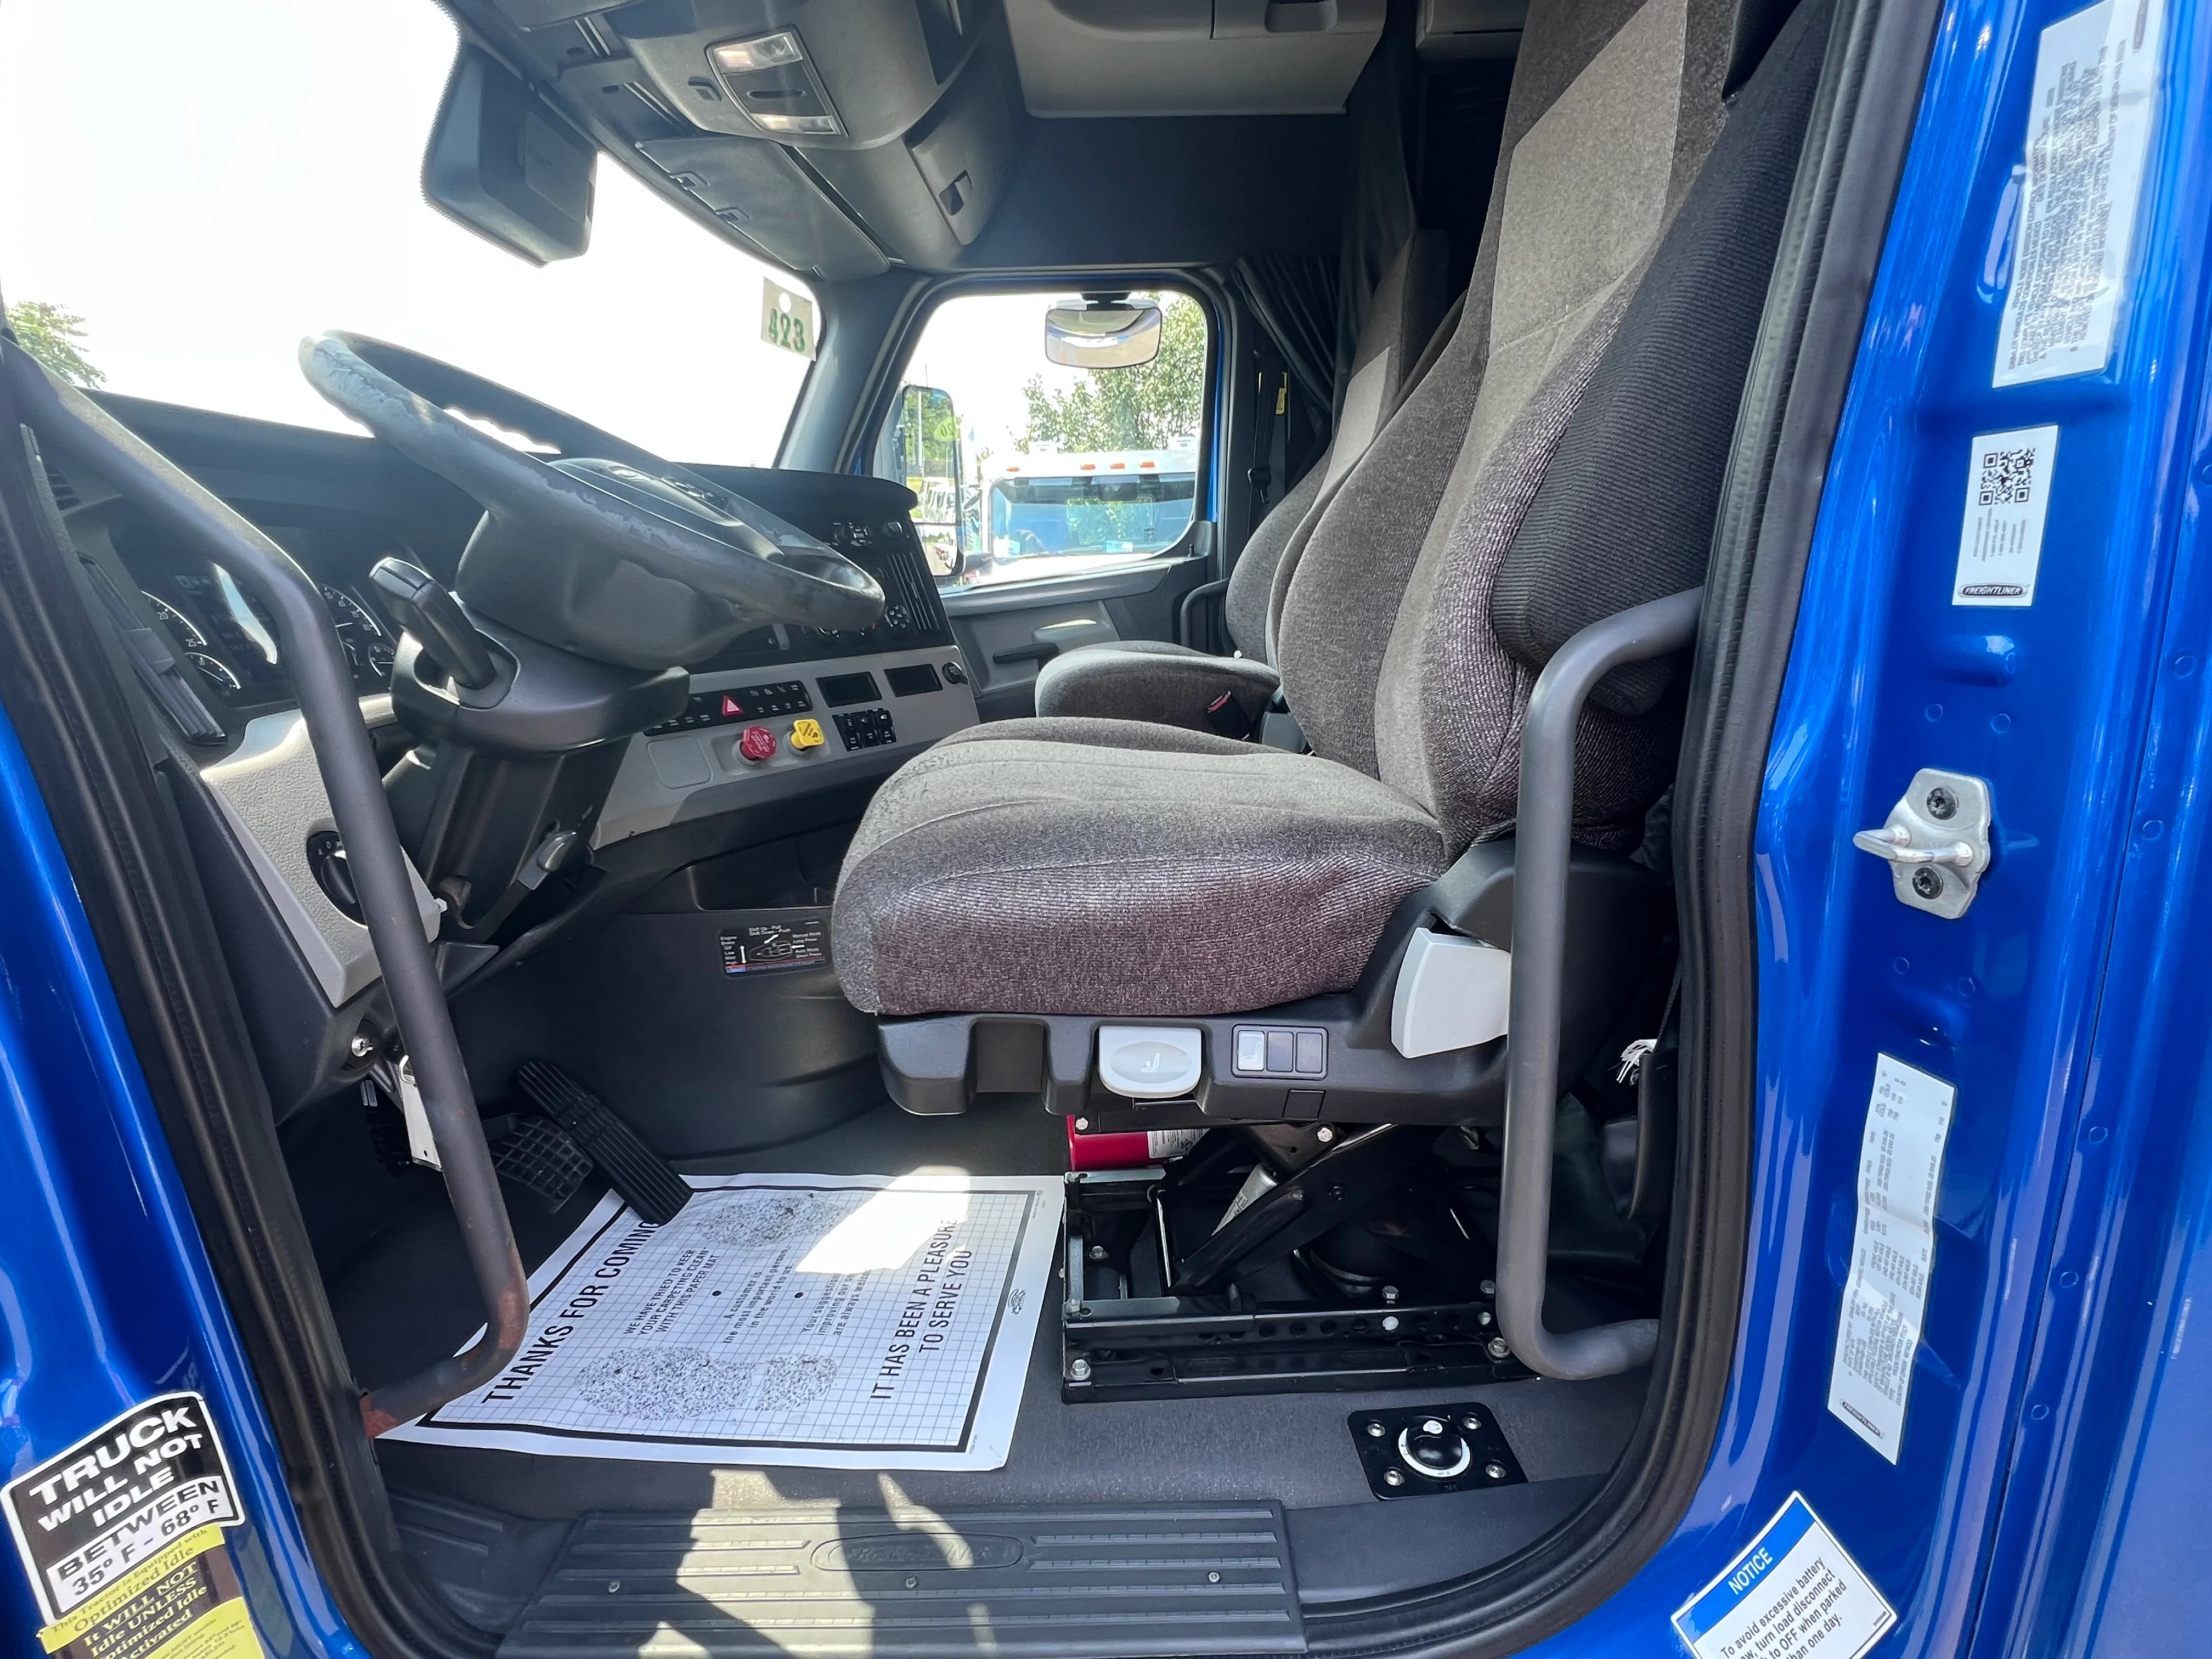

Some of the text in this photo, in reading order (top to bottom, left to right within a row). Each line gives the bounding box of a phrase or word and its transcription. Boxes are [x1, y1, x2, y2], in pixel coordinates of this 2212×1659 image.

[769, 308, 805, 353] 423
[917, 1220, 957, 1282] PLEASURE
[623, 1249, 696, 1334] WE HAVE TRIED TO KEEP
[637, 1314, 662, 1335] YOUR
[655, 1272, 694, 1312] CARPETING
[654, 1254, 721, 1332] WITH THIS PAPER MAT
[727, 1280, 758, 1312] customer
[752, 1307, 769, 1318] the
[761, 1285, 782, 1305] world
[894, 1302, 927, 1338] BEEN
[918, 1250, 972, 1352] TO SERVE YOU
[481, 1325, 574, 1404] THANKS
[558, 1285, 609, 1318] FOR
[721, 1331, 739, 1343] the
[731, 1310, 752, 1328] most
[801, 1315, 819, 1333] Your
[870, 1384, 894, 1398] IT
[879, 1344, 910, 1375] HAS
[29, 1407, 197, 1505] TRUCK
[38, 1434, 203, 1532] WILL NOT
[92, 1466, 174, 1527] IDLE
[57, 1481, 219, 1581] BETWEEN
[122, 1545, 138, 1564] F
[209, 1499, 219, 1514] F
[134, 1540, 183, 1578] Equipped
[184, 1530, 207, 1543] with
[74, 1569, 161, 1632] Optimized
[164, 1546, 194, 1572] Idle
[177, 1585, 207, 1610] Idle
[1728, 1548, 1773, 1595] NOTICE
[83, 1632, 100, 1646] It
[102, 1595, 156, 1632] WILL
[156, 1562, 196, 1594] NOT
[90, 1629, 126, 1658] Idle
[128, 1577, 197, 1629] UNLESS
[1720, 1557, 1825, 1658] To avoid excessive battery
[1755, 1631, 1776, 1651] turn
[1773, 1611, 1795, 1635] load
[1793, 1568, 1836, 1616] disconnect
[1769, 1579, 1847, 1658] to OFF when parked
[1808, 1630, 1824, 1648] one
[1824, 1613, 1842, 1633] day.
